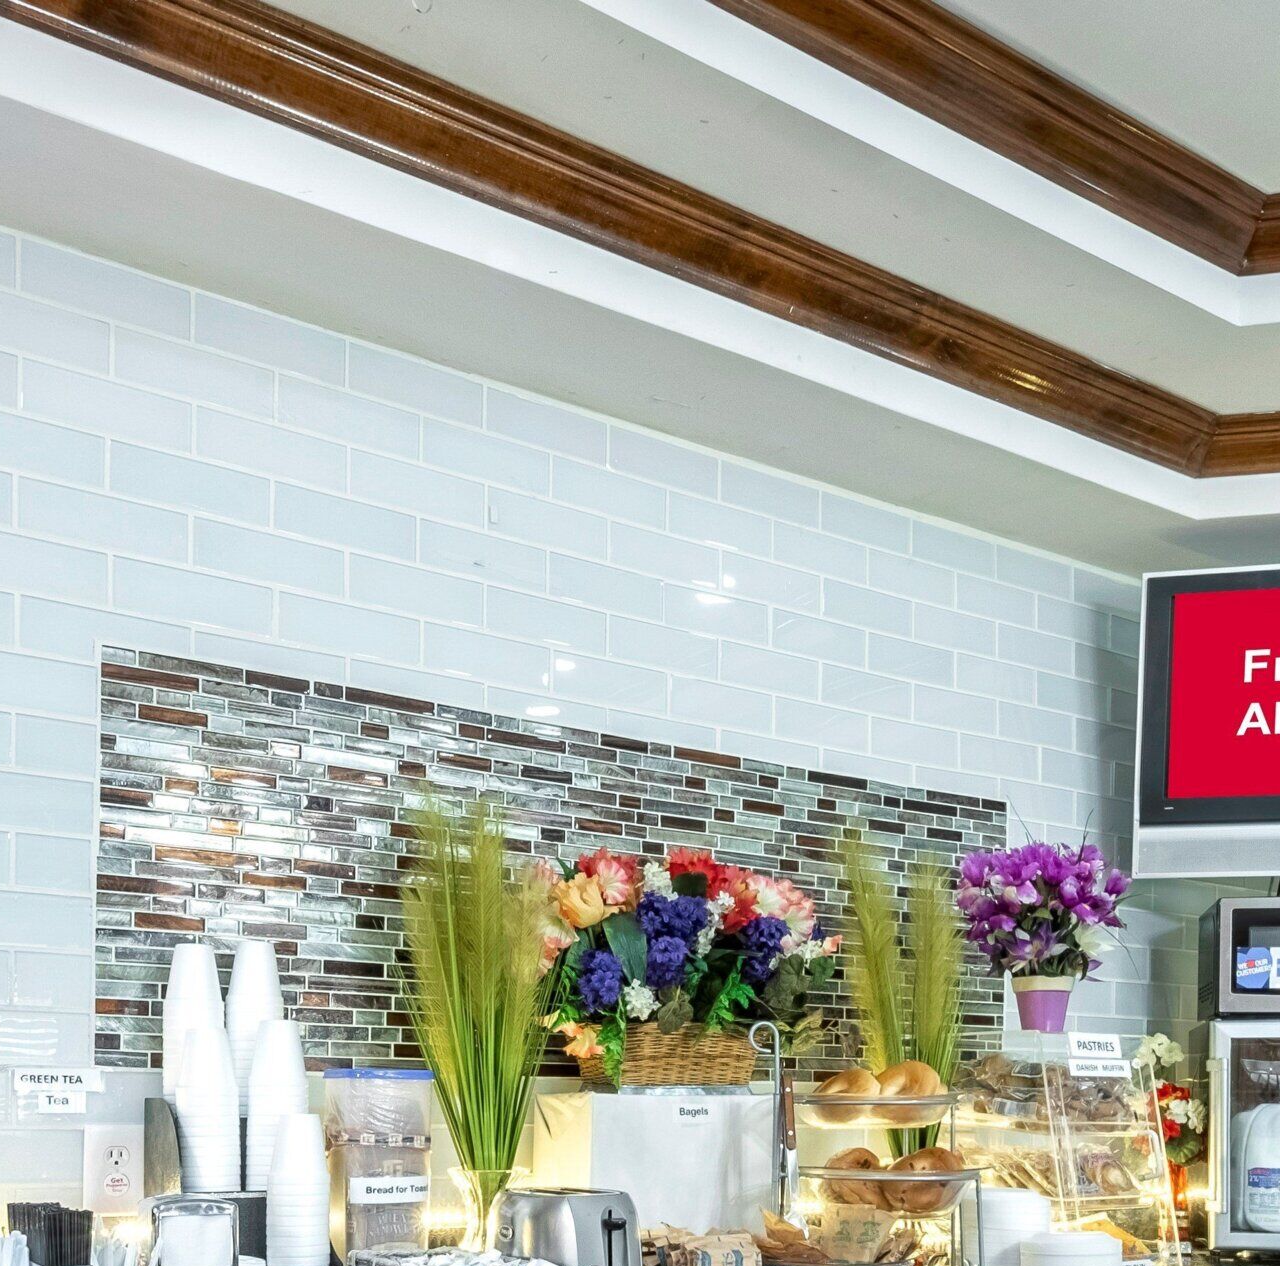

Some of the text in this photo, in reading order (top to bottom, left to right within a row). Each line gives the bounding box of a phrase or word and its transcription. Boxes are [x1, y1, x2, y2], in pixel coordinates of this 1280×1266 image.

[1077, 1041, 1115, 1052] PASTRIES
[1075, 1063, 1125, 1072] DANISH MUFFIN
[20, 1074, 83, 1084] GREEN TEA
[45, 1095, 69, 1105] Tea
[679, 1107, 709, 1118] Bagels
[365, 1186, 394, 1194] Bread
[395, 1186, 408, 1194] for
